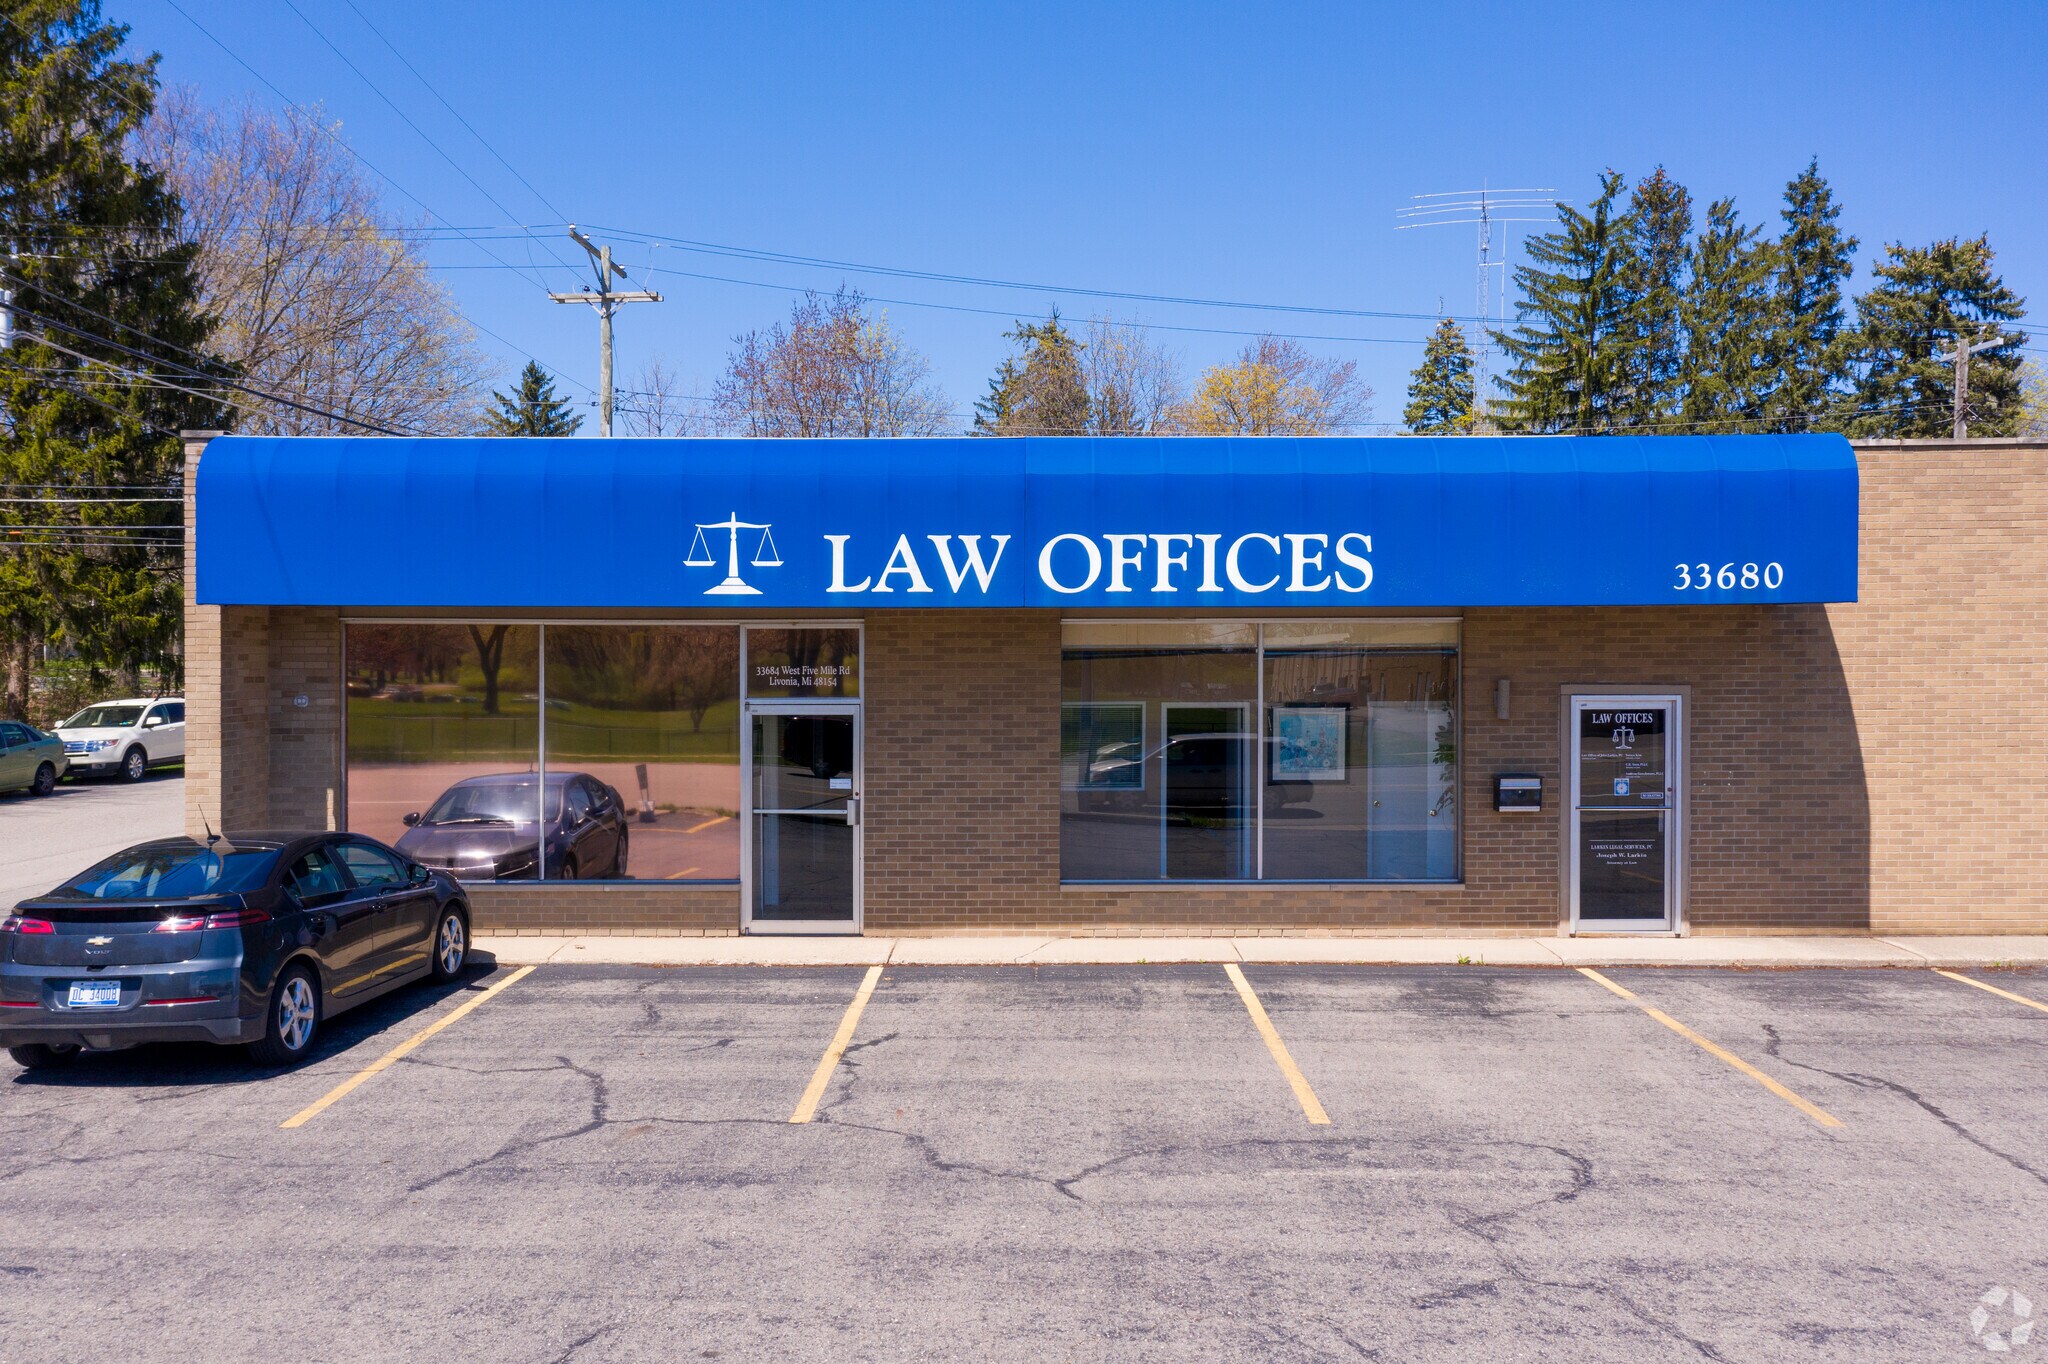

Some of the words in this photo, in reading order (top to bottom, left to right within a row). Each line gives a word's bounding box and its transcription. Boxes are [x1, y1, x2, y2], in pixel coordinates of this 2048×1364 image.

[824, 533, 1011, 593] LAW
[1037, 532, 1374, 594] OFFICES
[1673, 562, 1784, 590] 33680
[756, 666, 780, 676] 33684
[781, 666, 800, 675] West
[802, 666, 818, 675] Five
[820, 666, 837, 675] Mile
[839, 666, 850, 675] Rd
[769, 677, 800, 687] Livonia,
[802, 677, 812, 686] Mi
[813, 677, 837, 687] 48154
[1592, 713, 1612, 723] LAW
[1615, 713, 1653, 723] OFFICES
